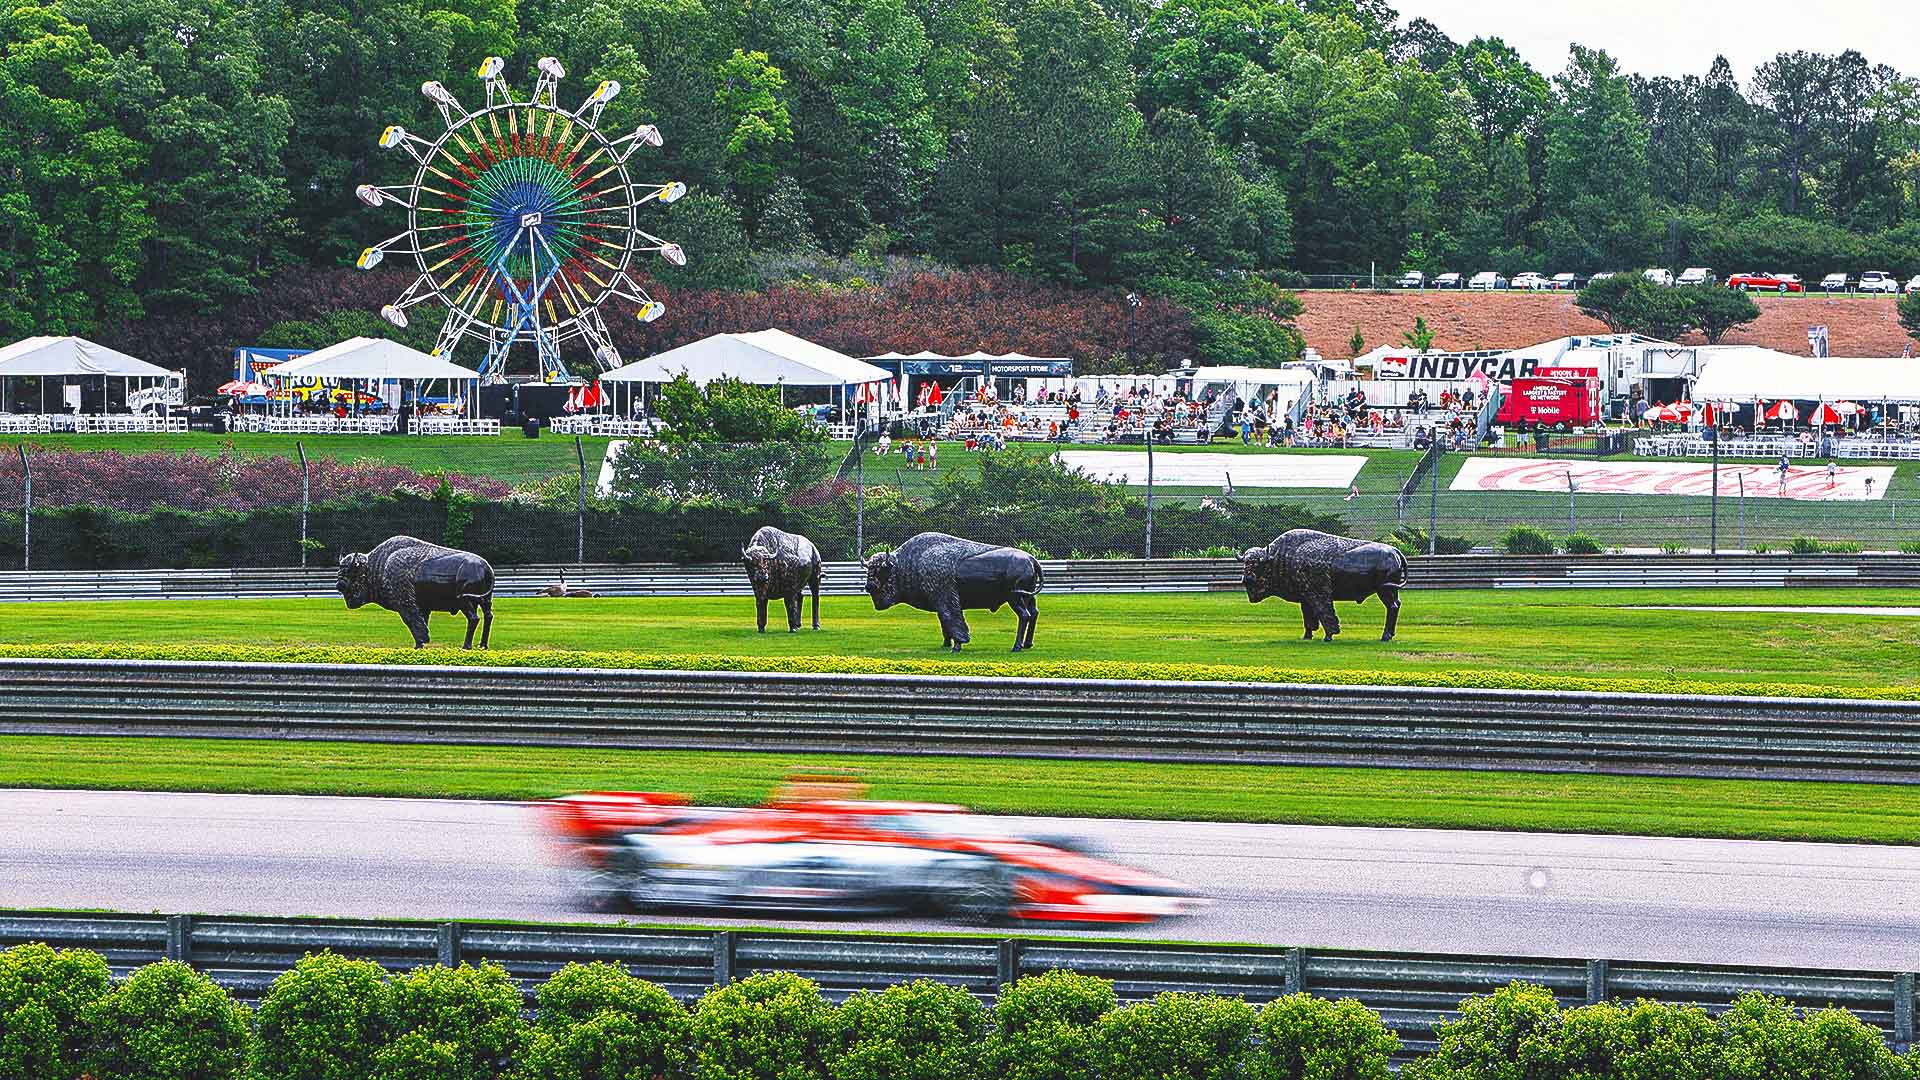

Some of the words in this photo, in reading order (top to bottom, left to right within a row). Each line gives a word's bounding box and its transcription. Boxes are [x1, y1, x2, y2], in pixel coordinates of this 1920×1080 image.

[992, 365, 1029, 373] MOTORSPORT
[1408, 357, 1538, 379] INDYCAR
[1538, 406, 1560, 414] Mobile
